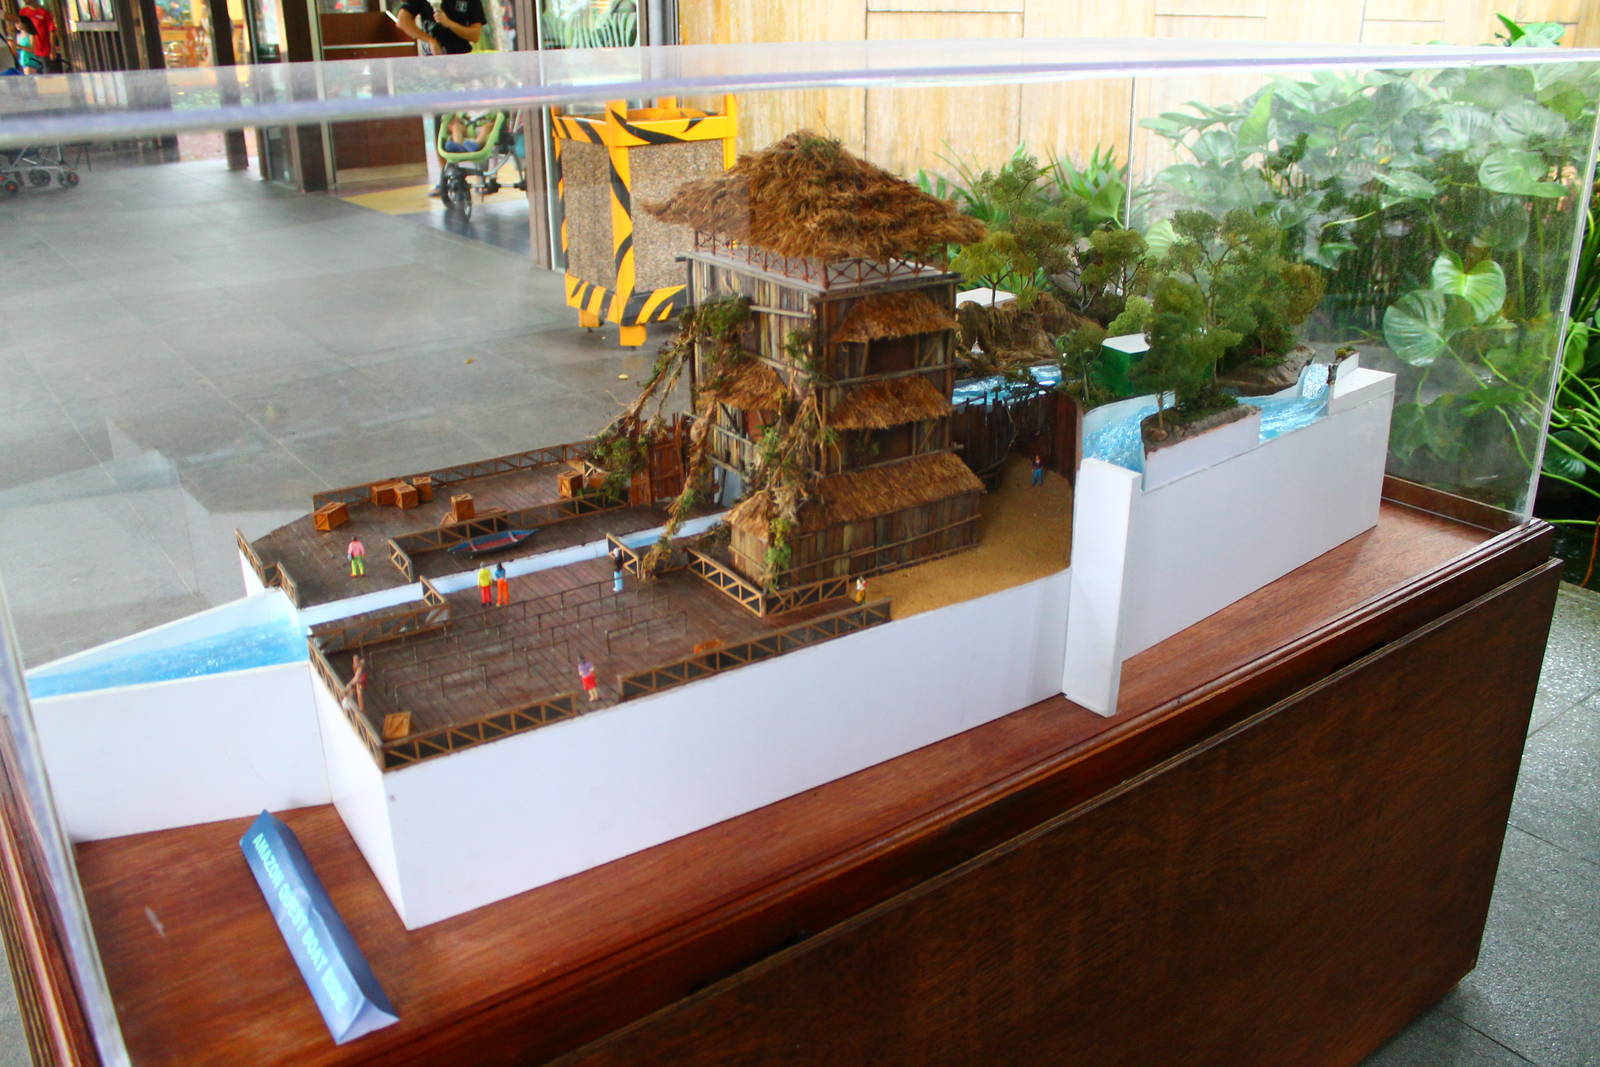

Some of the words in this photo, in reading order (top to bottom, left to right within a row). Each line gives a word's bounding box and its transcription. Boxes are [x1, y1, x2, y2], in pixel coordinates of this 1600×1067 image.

[253, 833, 285, 889] AMAZON
[278, 882, 309, 932] QUEST
[302, 926, 328, 972] BOAT
[321, 971, 349, 1013] RIDE
